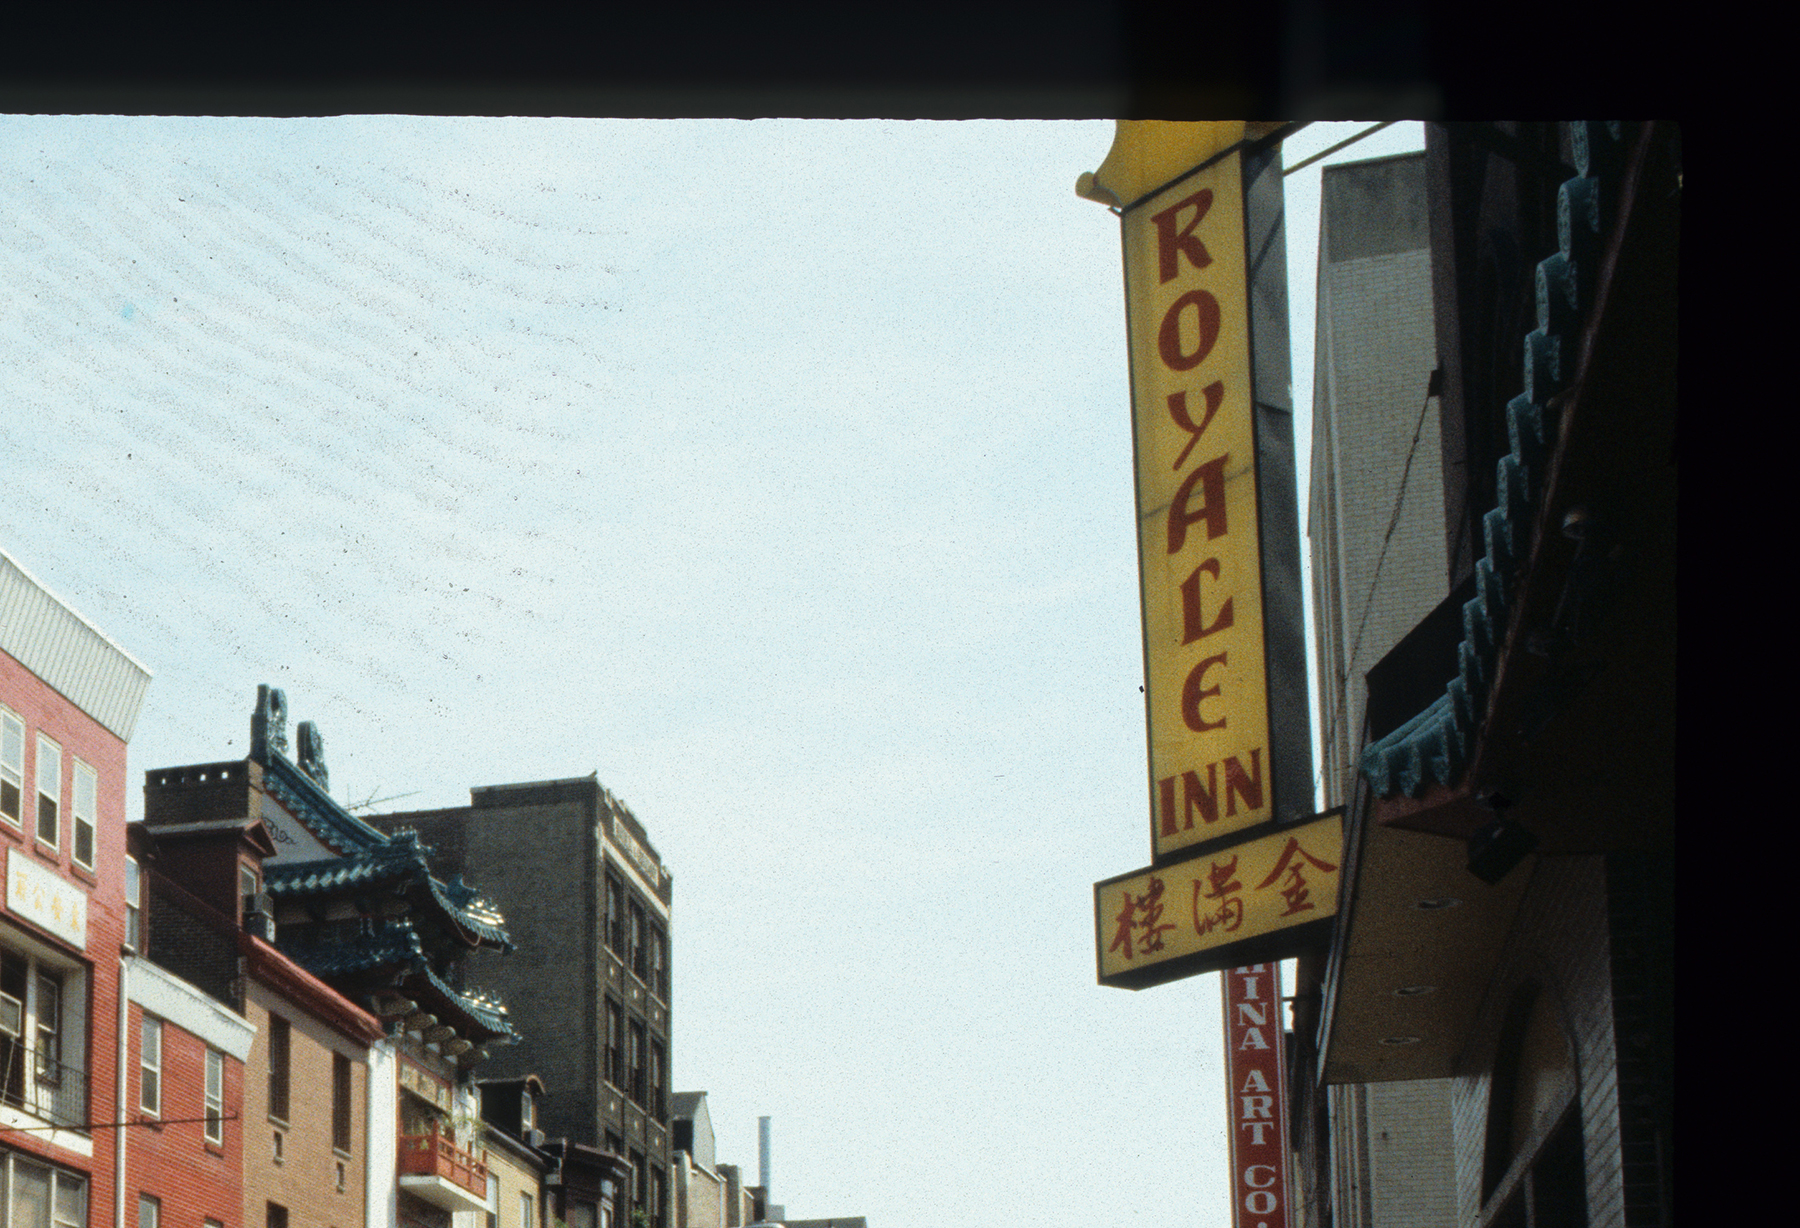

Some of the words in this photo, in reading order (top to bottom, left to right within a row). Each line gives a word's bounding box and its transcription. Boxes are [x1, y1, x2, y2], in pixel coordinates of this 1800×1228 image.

[1149, 187, 1236, 734] ROYALE
[1157, 748, 1265, 839] INN
[1240, 1068, 1274, 1146] ART
